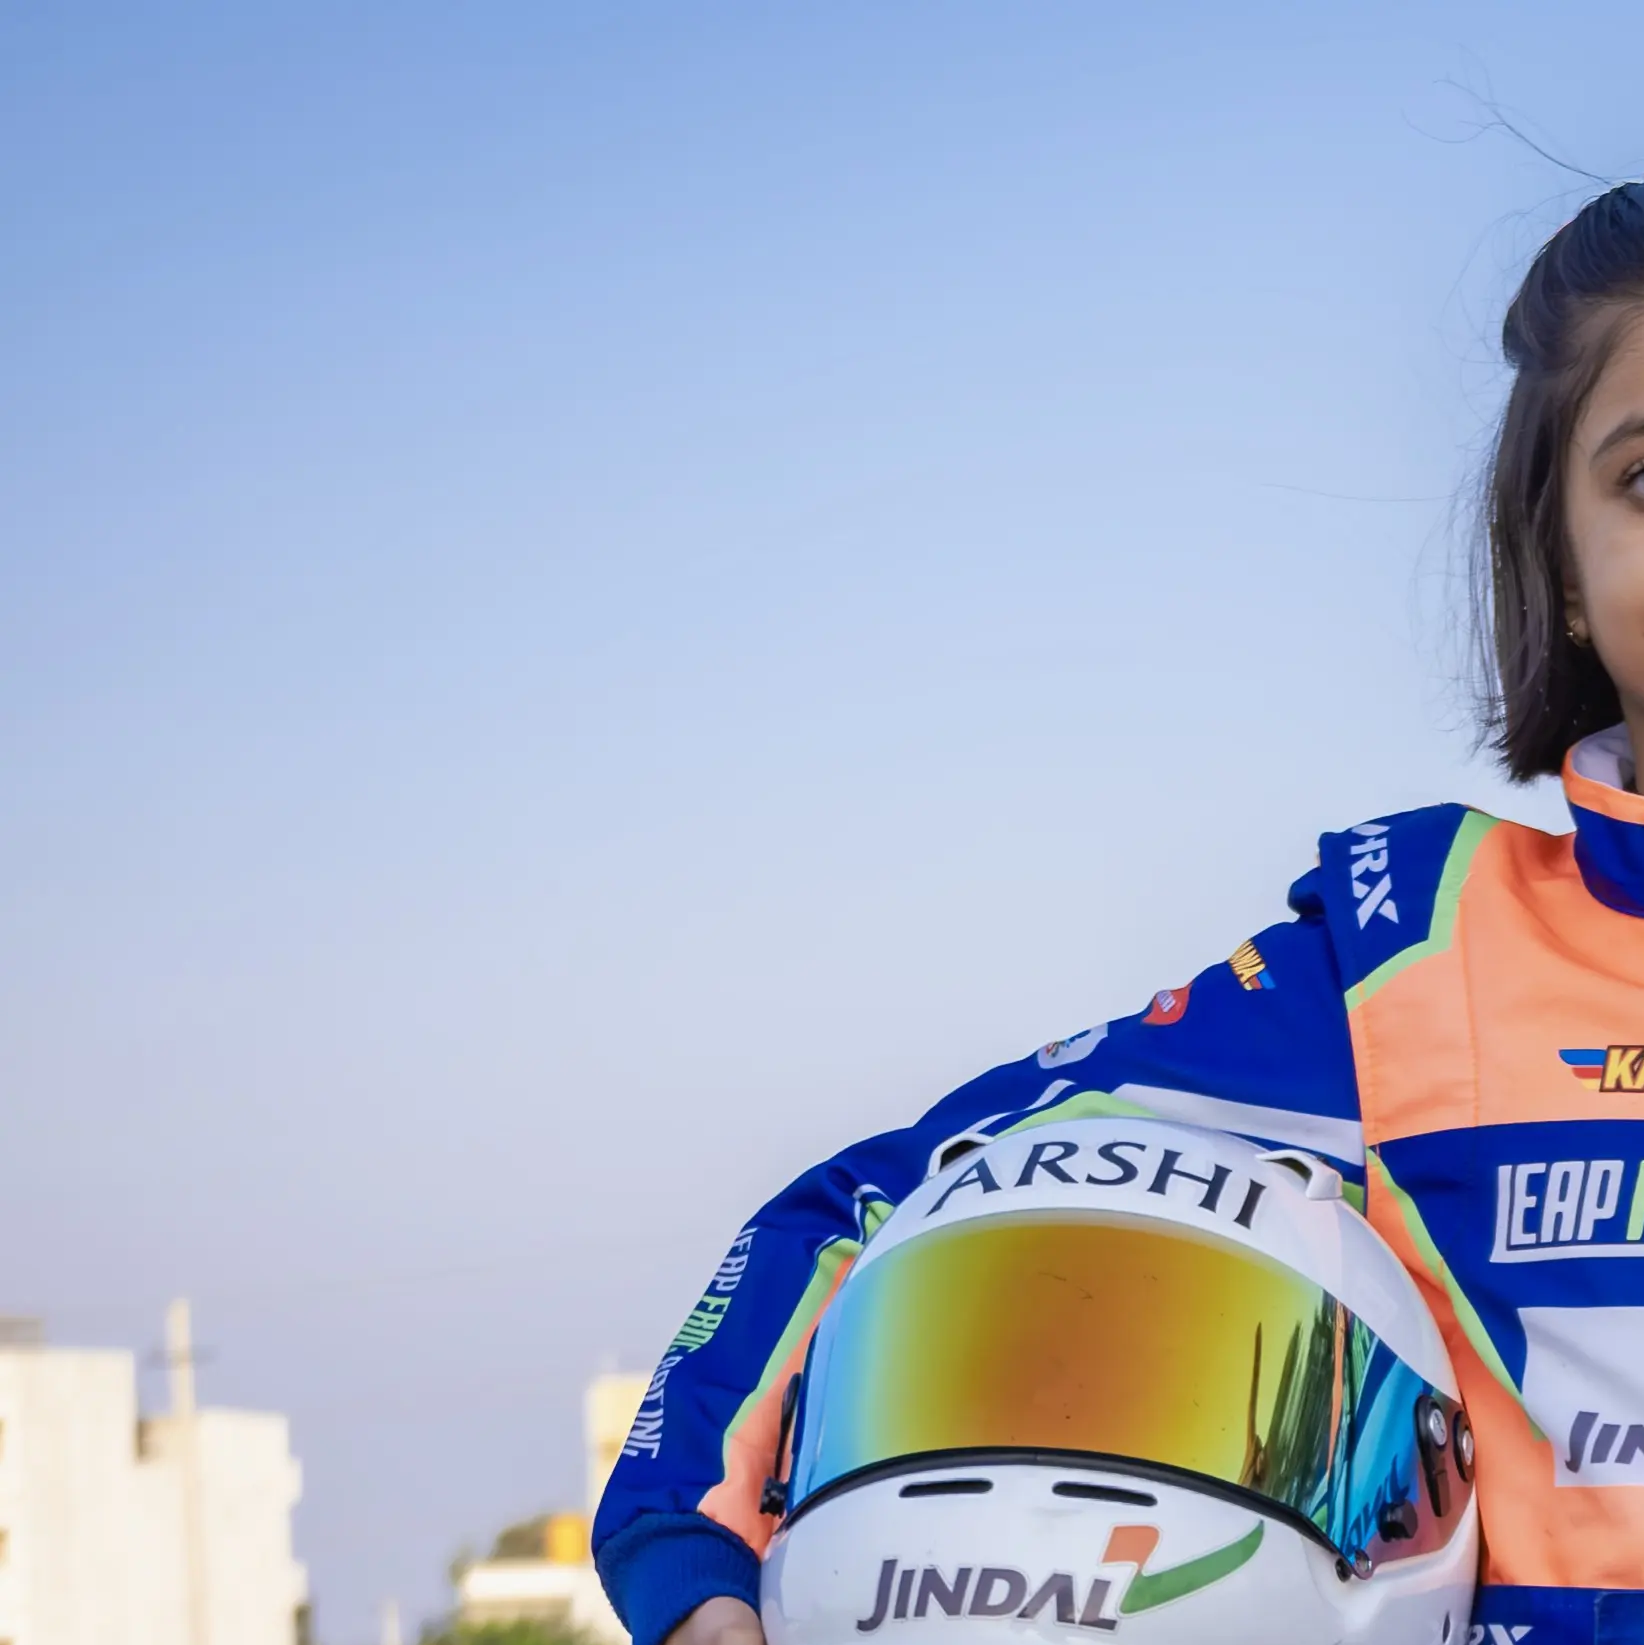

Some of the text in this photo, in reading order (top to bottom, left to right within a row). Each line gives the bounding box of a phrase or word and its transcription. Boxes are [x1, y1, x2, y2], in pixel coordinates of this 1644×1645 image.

[1350, 823, 1400, 931] HRX
[924, 1141, 1267, 1230] ARSHI
[1490, 1159, 1624, 1263] LEAP
[855, 1558, 1118, 1632] JINDAL
